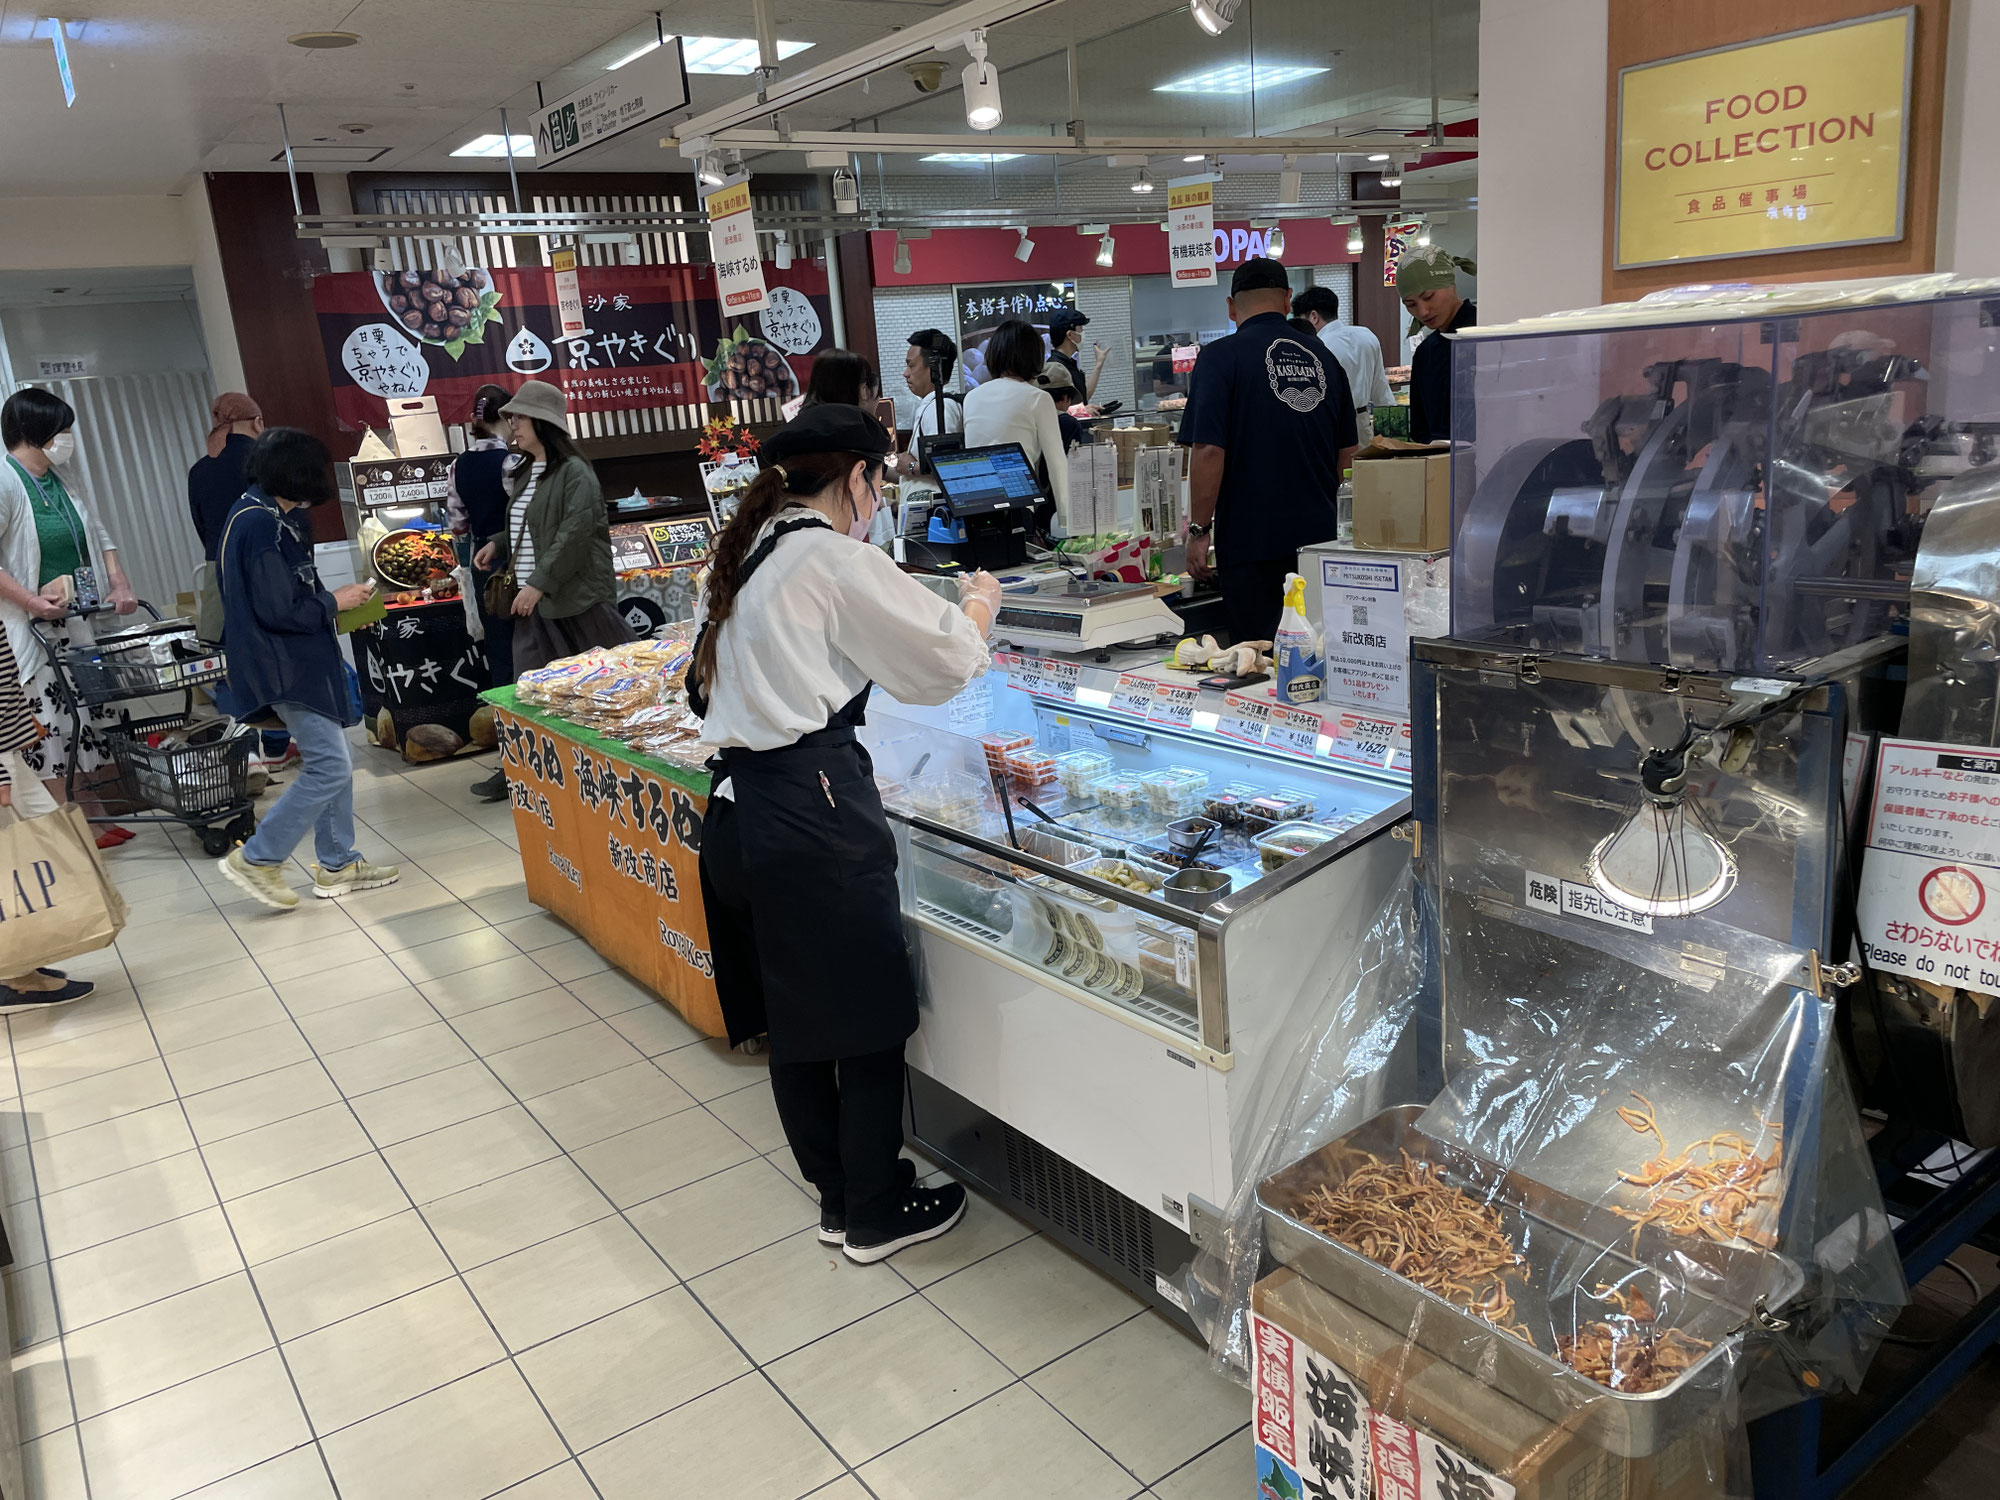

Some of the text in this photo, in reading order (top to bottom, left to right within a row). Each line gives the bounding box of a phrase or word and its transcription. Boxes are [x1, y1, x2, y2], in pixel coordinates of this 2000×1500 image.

[1705, 85, 1807, 124] FOOD
[1645, 113, 1875, 171] COLLECTION
[1687, 185, 1807, 215] 食品催事場
[1172, 242, 1213, 259] 有機栽培茶
[718, 256, 759, 279] 海峡するめ
[581, 293, 633, 312] 沙家
[771, 290, 790, 304] 甘栗
[965, 294, 1068, 317] 本格手作り点心。
[766, 305, 807, 317] ちゃうで
[359, 328, 385, 344] 甘栗
[766, 319, 816, 338] 京やきぐり
[551, 323, 697, 371] 京やきぐり
[783, 335, 813, 347] やねん
[351, 345, 408, 359] ちゃうで
[351, 360, 421, 383] 京やきぐり
[378, 382, 418, 394] やねん
[1344, 573, 1372, 581] MITSUKOSHI
[1342, 630, 1387, 649] 新改商店
[375, 643, 490, 704] やきぐ
[1128, 695, 1150, 706] ¥1620
[1352, 690, 1380, 701] いたします。
[1170, 706, 1193, 717] ¥1404
[1240, 702, 1270, 717] つぶ甘露煮
[1287, 712, 1319, 728] いかみぞれ
[1356, 720, 1394, 736] たこわさび
[1356, 740, 1387, 755] ¥1620
[1960, 758, 1998, 772] ご案内
[506, 778, 554, 829] 改店
[571, 746, 703, 852] 海峡するめ
[1883, 803, 2000, 828] 保護者様ご了承のもとご
[1880, 823, 1954, 839] いたしております。
[609, 834, 679, 902] 新改商店
[0, 858, 57, 923] AP
[1529, 879, 1558, 905] 危険
[1862, 942, 1907, 967] Please
[1916, 954, 1935, 973] do
[1944, 961, 1970, 981] not
